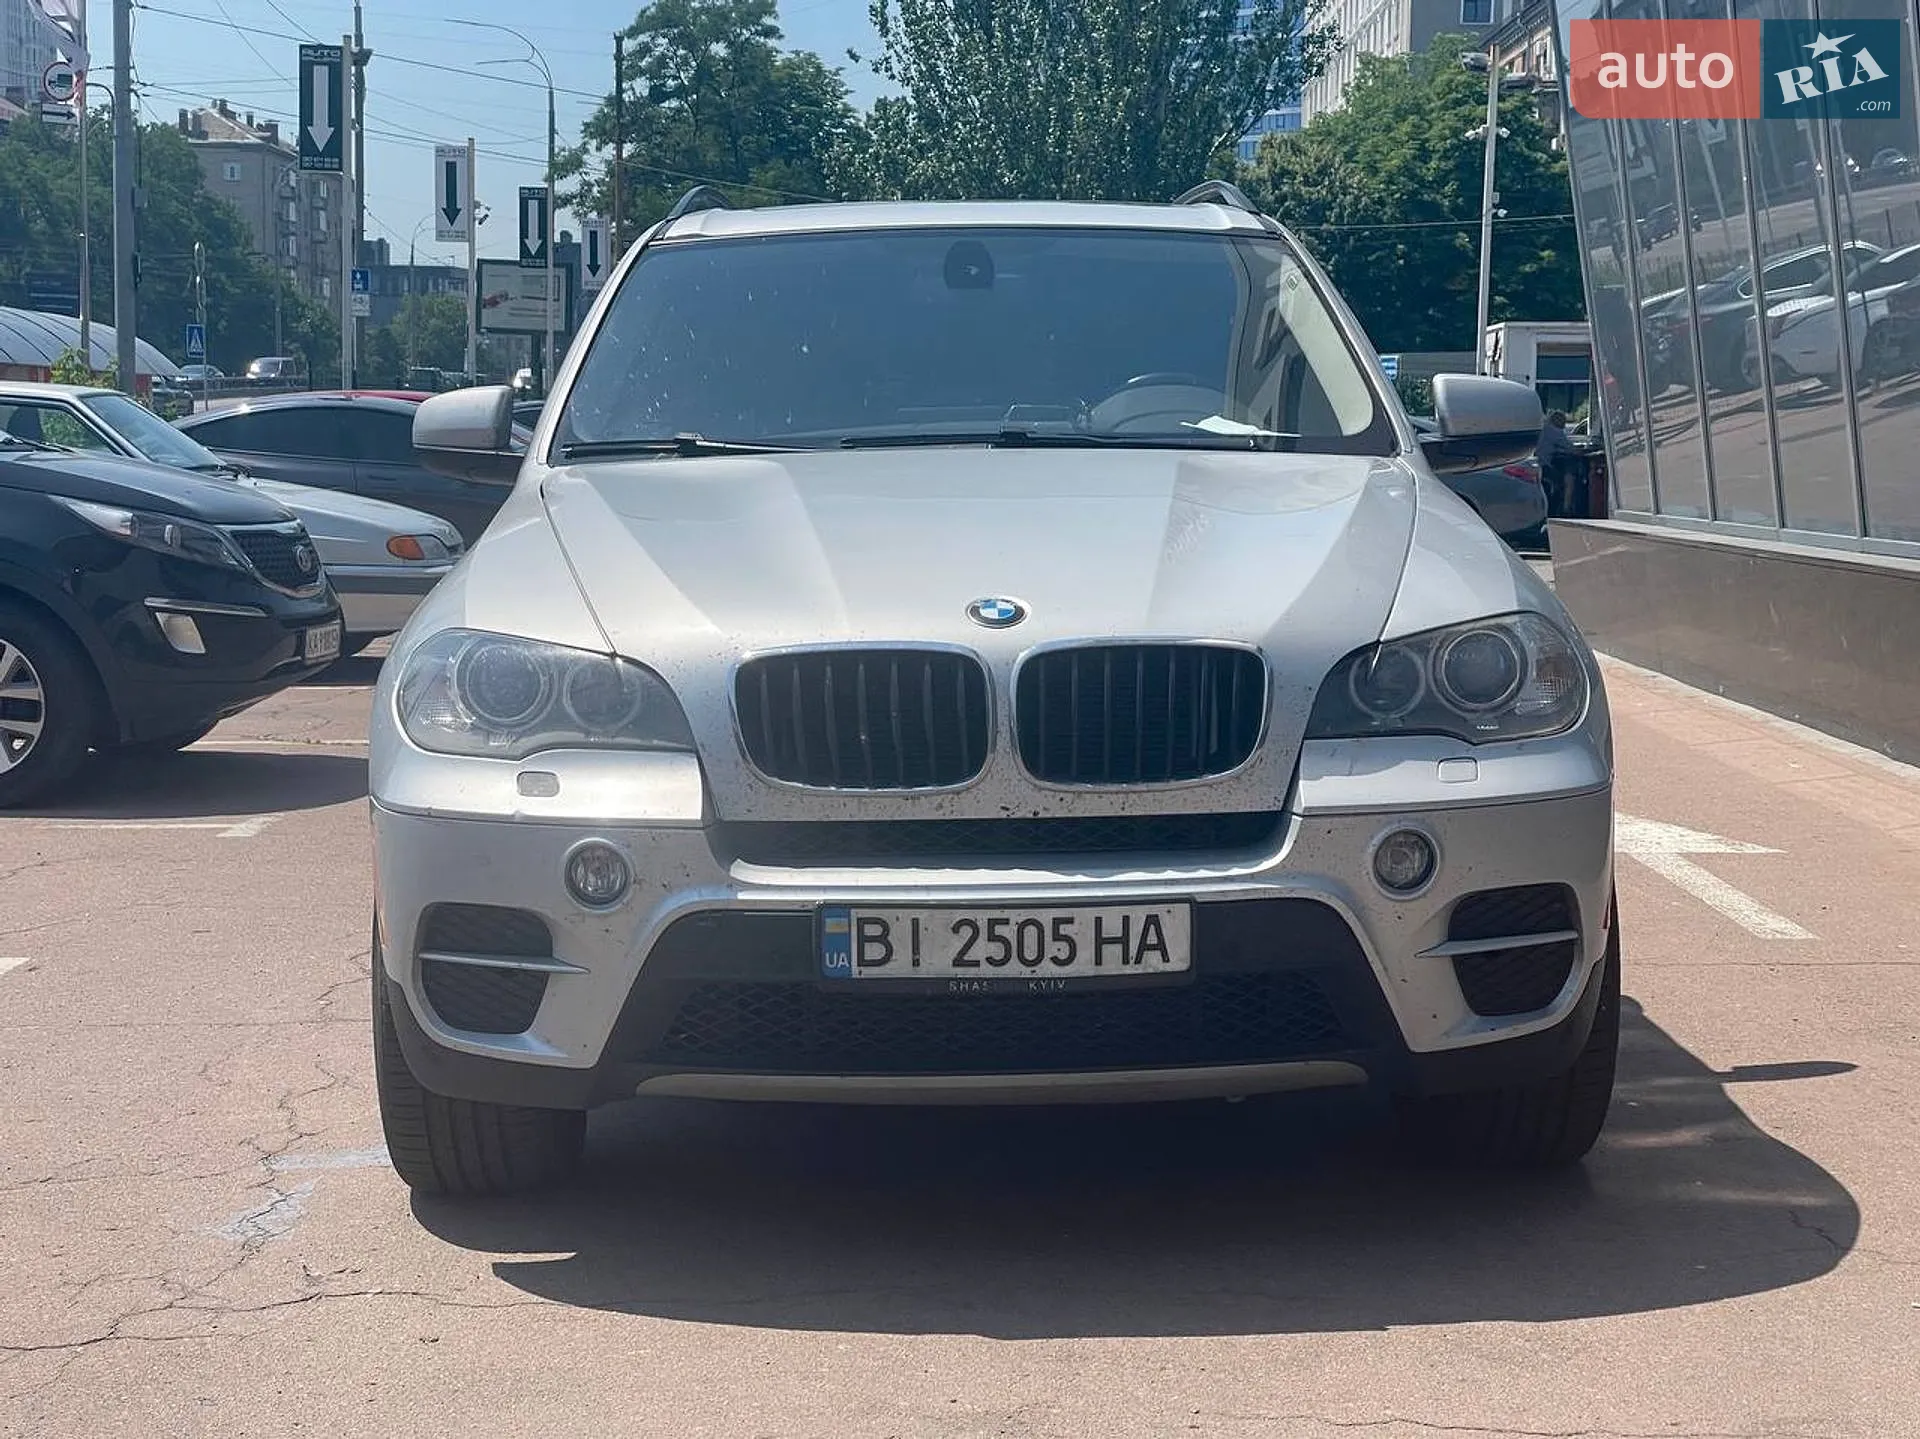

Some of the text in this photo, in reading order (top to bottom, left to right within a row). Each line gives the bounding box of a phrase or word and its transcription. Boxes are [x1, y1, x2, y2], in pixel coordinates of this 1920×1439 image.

[951, 916, 1077, 968] 2505
[1094, 913, 1171, 966] HA
[826, 952, 850, 969] UA
